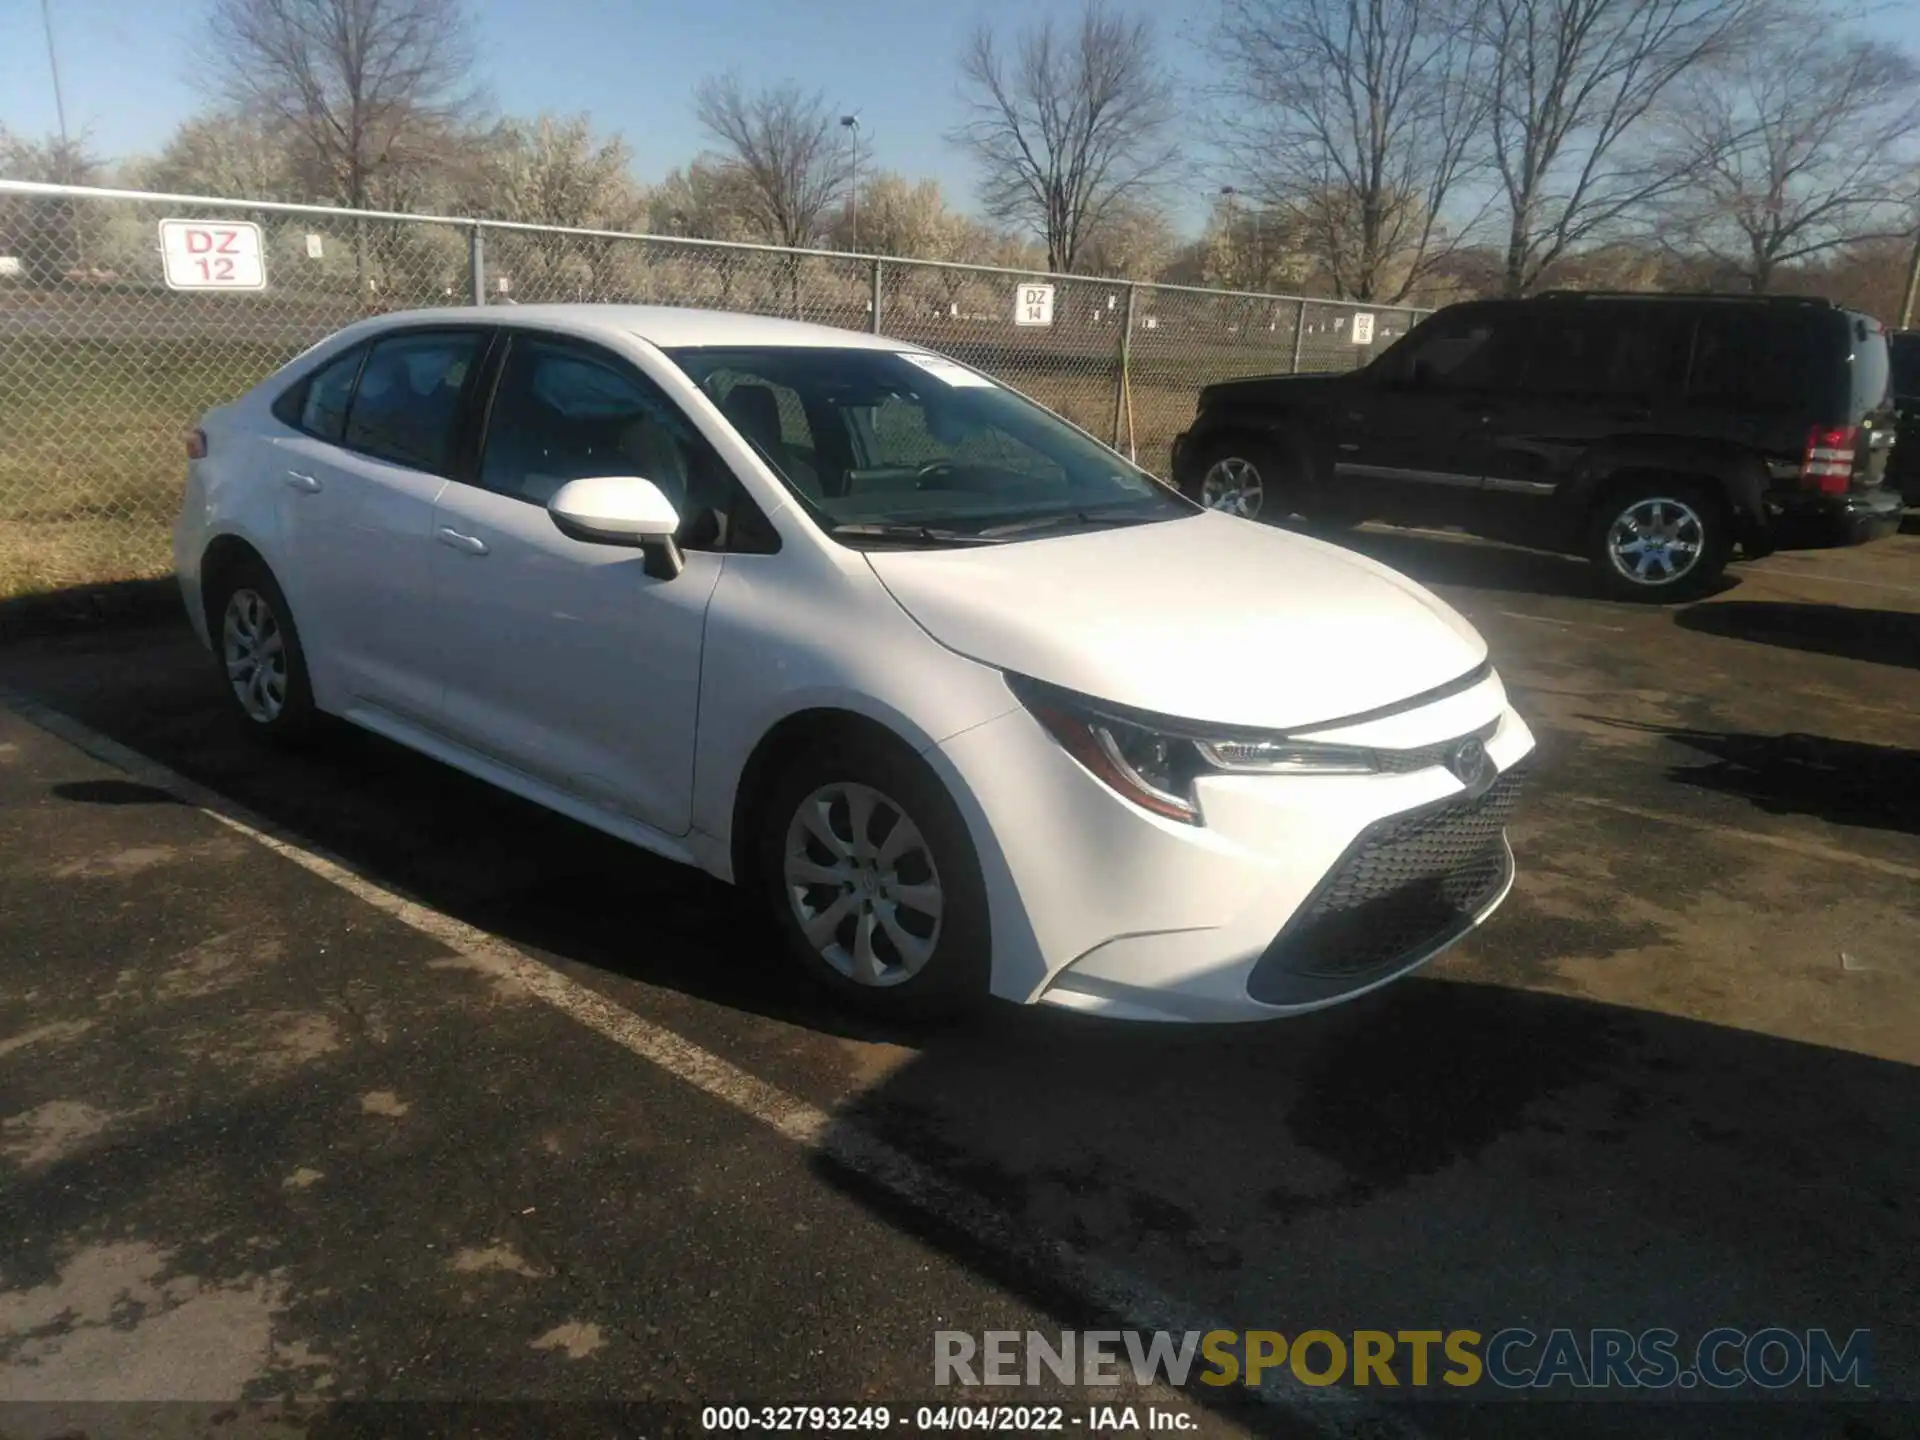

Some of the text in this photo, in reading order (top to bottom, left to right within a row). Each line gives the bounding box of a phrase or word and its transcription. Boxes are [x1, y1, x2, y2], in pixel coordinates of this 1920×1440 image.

[185, 229, 240, 254] DZ
[195, 257, 235, 280] 12
[1026, 289, 1046, 305] DZ
[1026, 306, 1041, 320] 14
